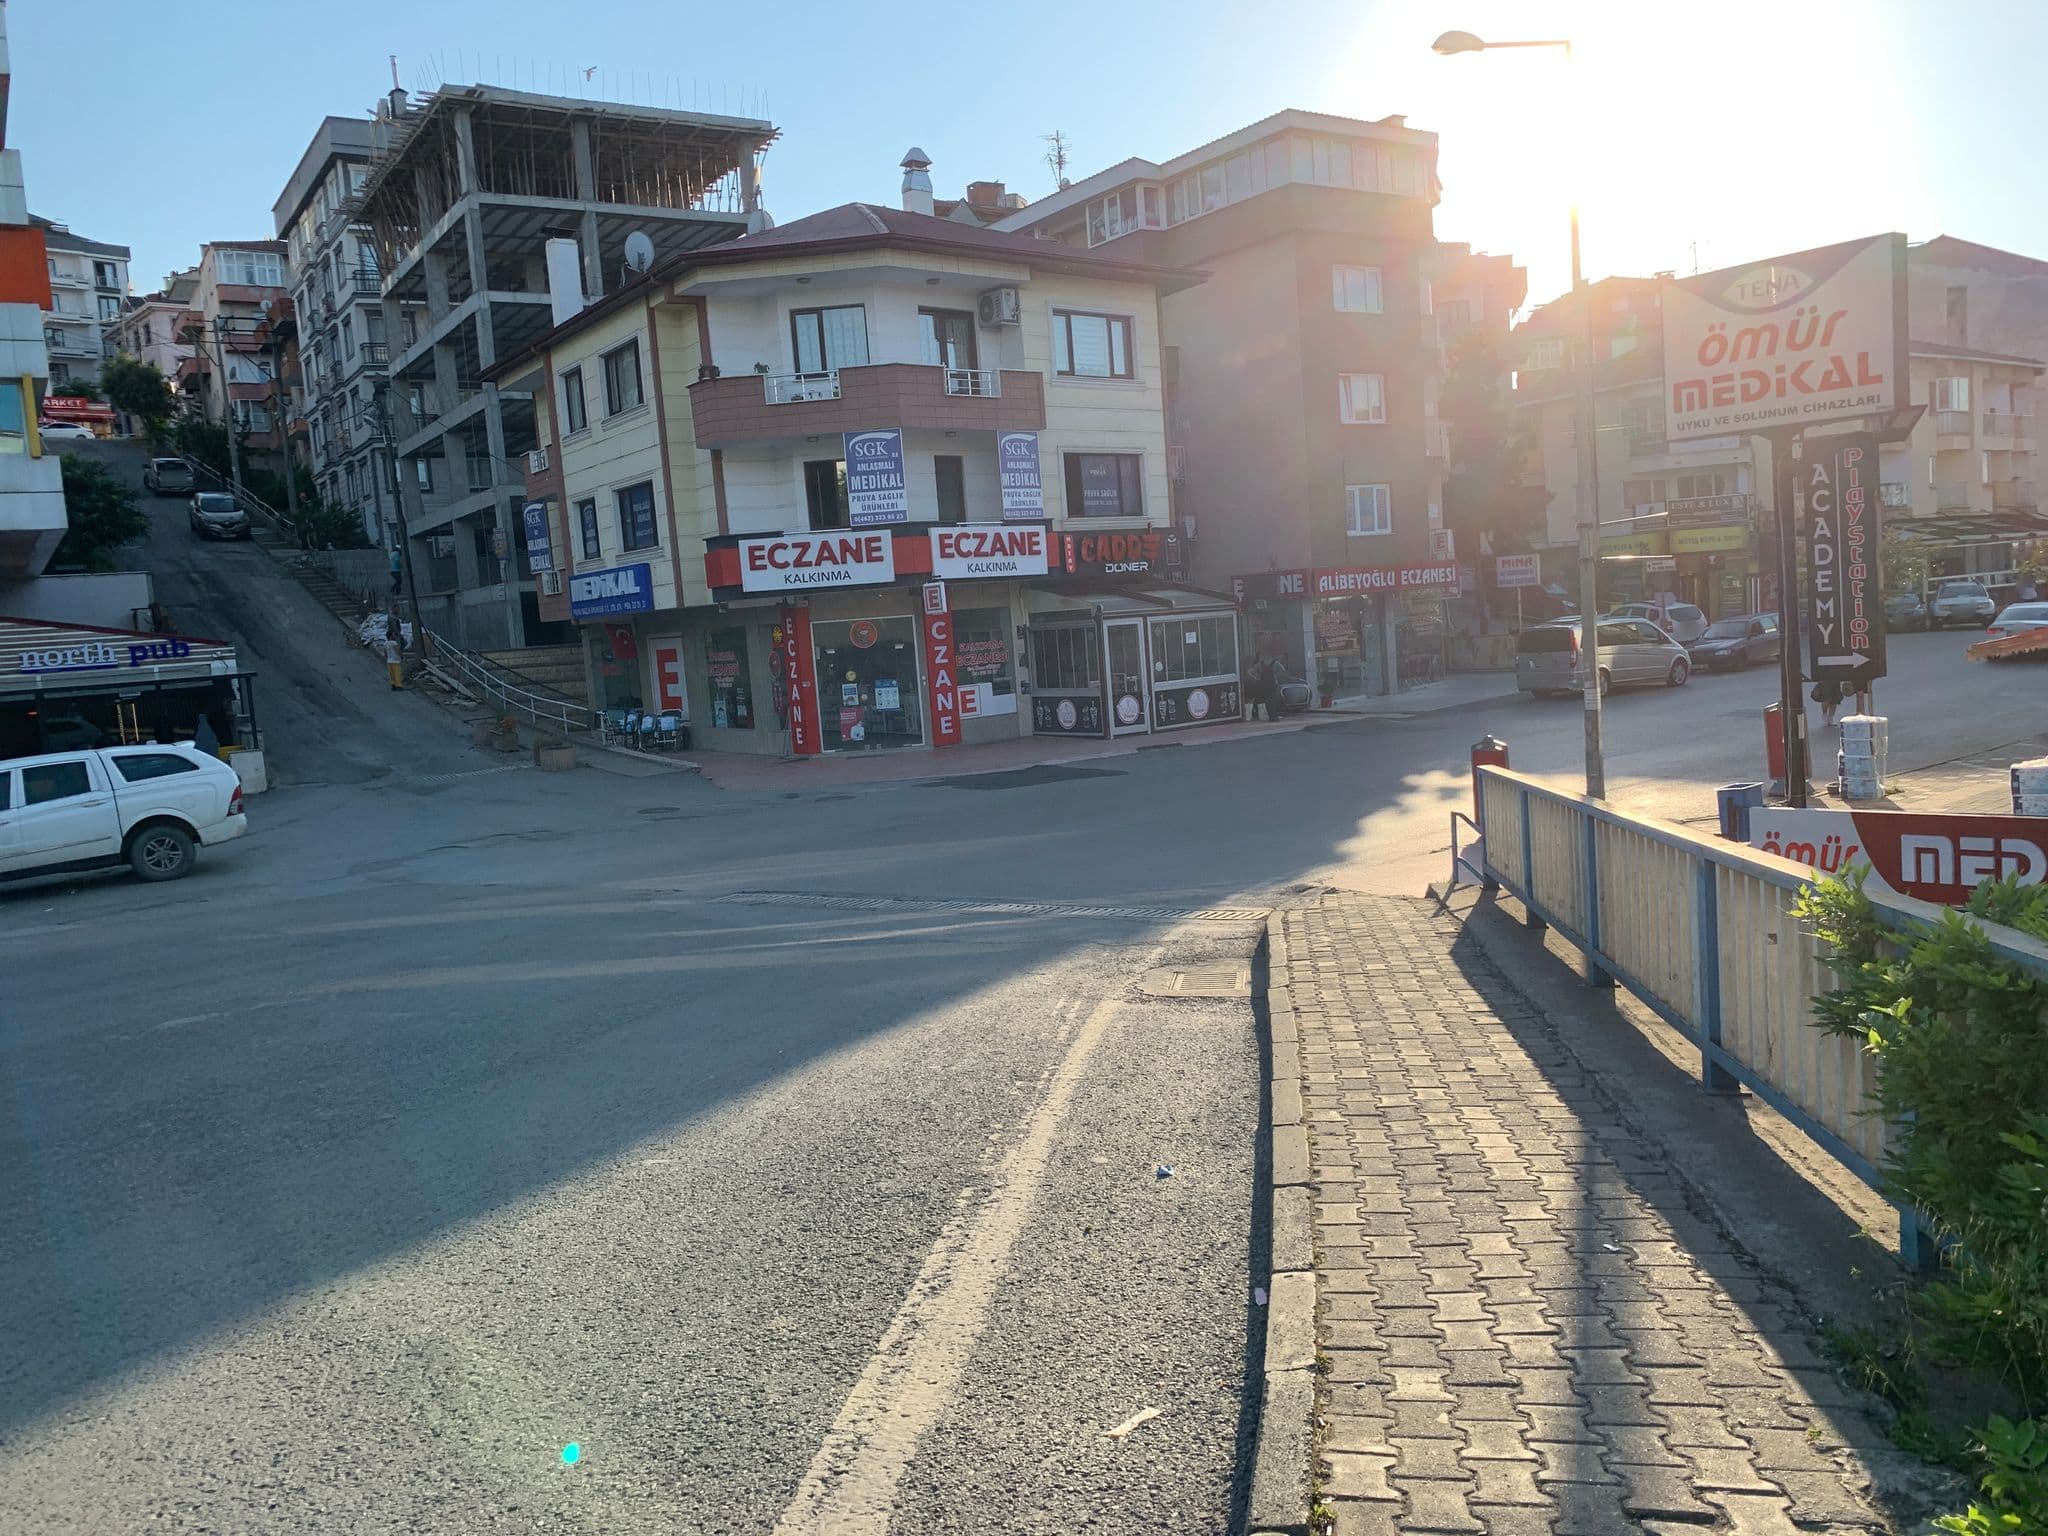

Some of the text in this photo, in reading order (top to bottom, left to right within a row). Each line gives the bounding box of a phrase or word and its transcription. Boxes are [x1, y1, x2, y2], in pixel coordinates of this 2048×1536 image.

[1735, 274, 1800, 300] TENA
[1698, 305, 1848, 367] ömür
[1673, 351, 1883, 413] MEDİKAL
[1677, 394, 1881, 431] UYKU VE SOLUNUM CİHAZLARI
[855, 441, 888, 457] SGK
[1005, 442, 1030, 456] SGK
[851, 472, 903, 490] MEDİKAL
[1002, 471, 1040, 487] MEDİKAL
[747, 536, 884, 571] ECZANE
[938, 531, 1042, 559] ECZANE
[1811, 463, 1834, 645] ACADEMY
[783, 570, 852, 584] KALKINMA
[967, 561, 1018, 574] KALKINMA
[1319, 565, 1456, 593] ALİBEYOĞLU ECZANESİ
[19, 638, 190, 668] north pub
[656, 649, 682, 710] E
[785, 618, 803, 744] ECZANE
[960, 689, 977, 714] E
